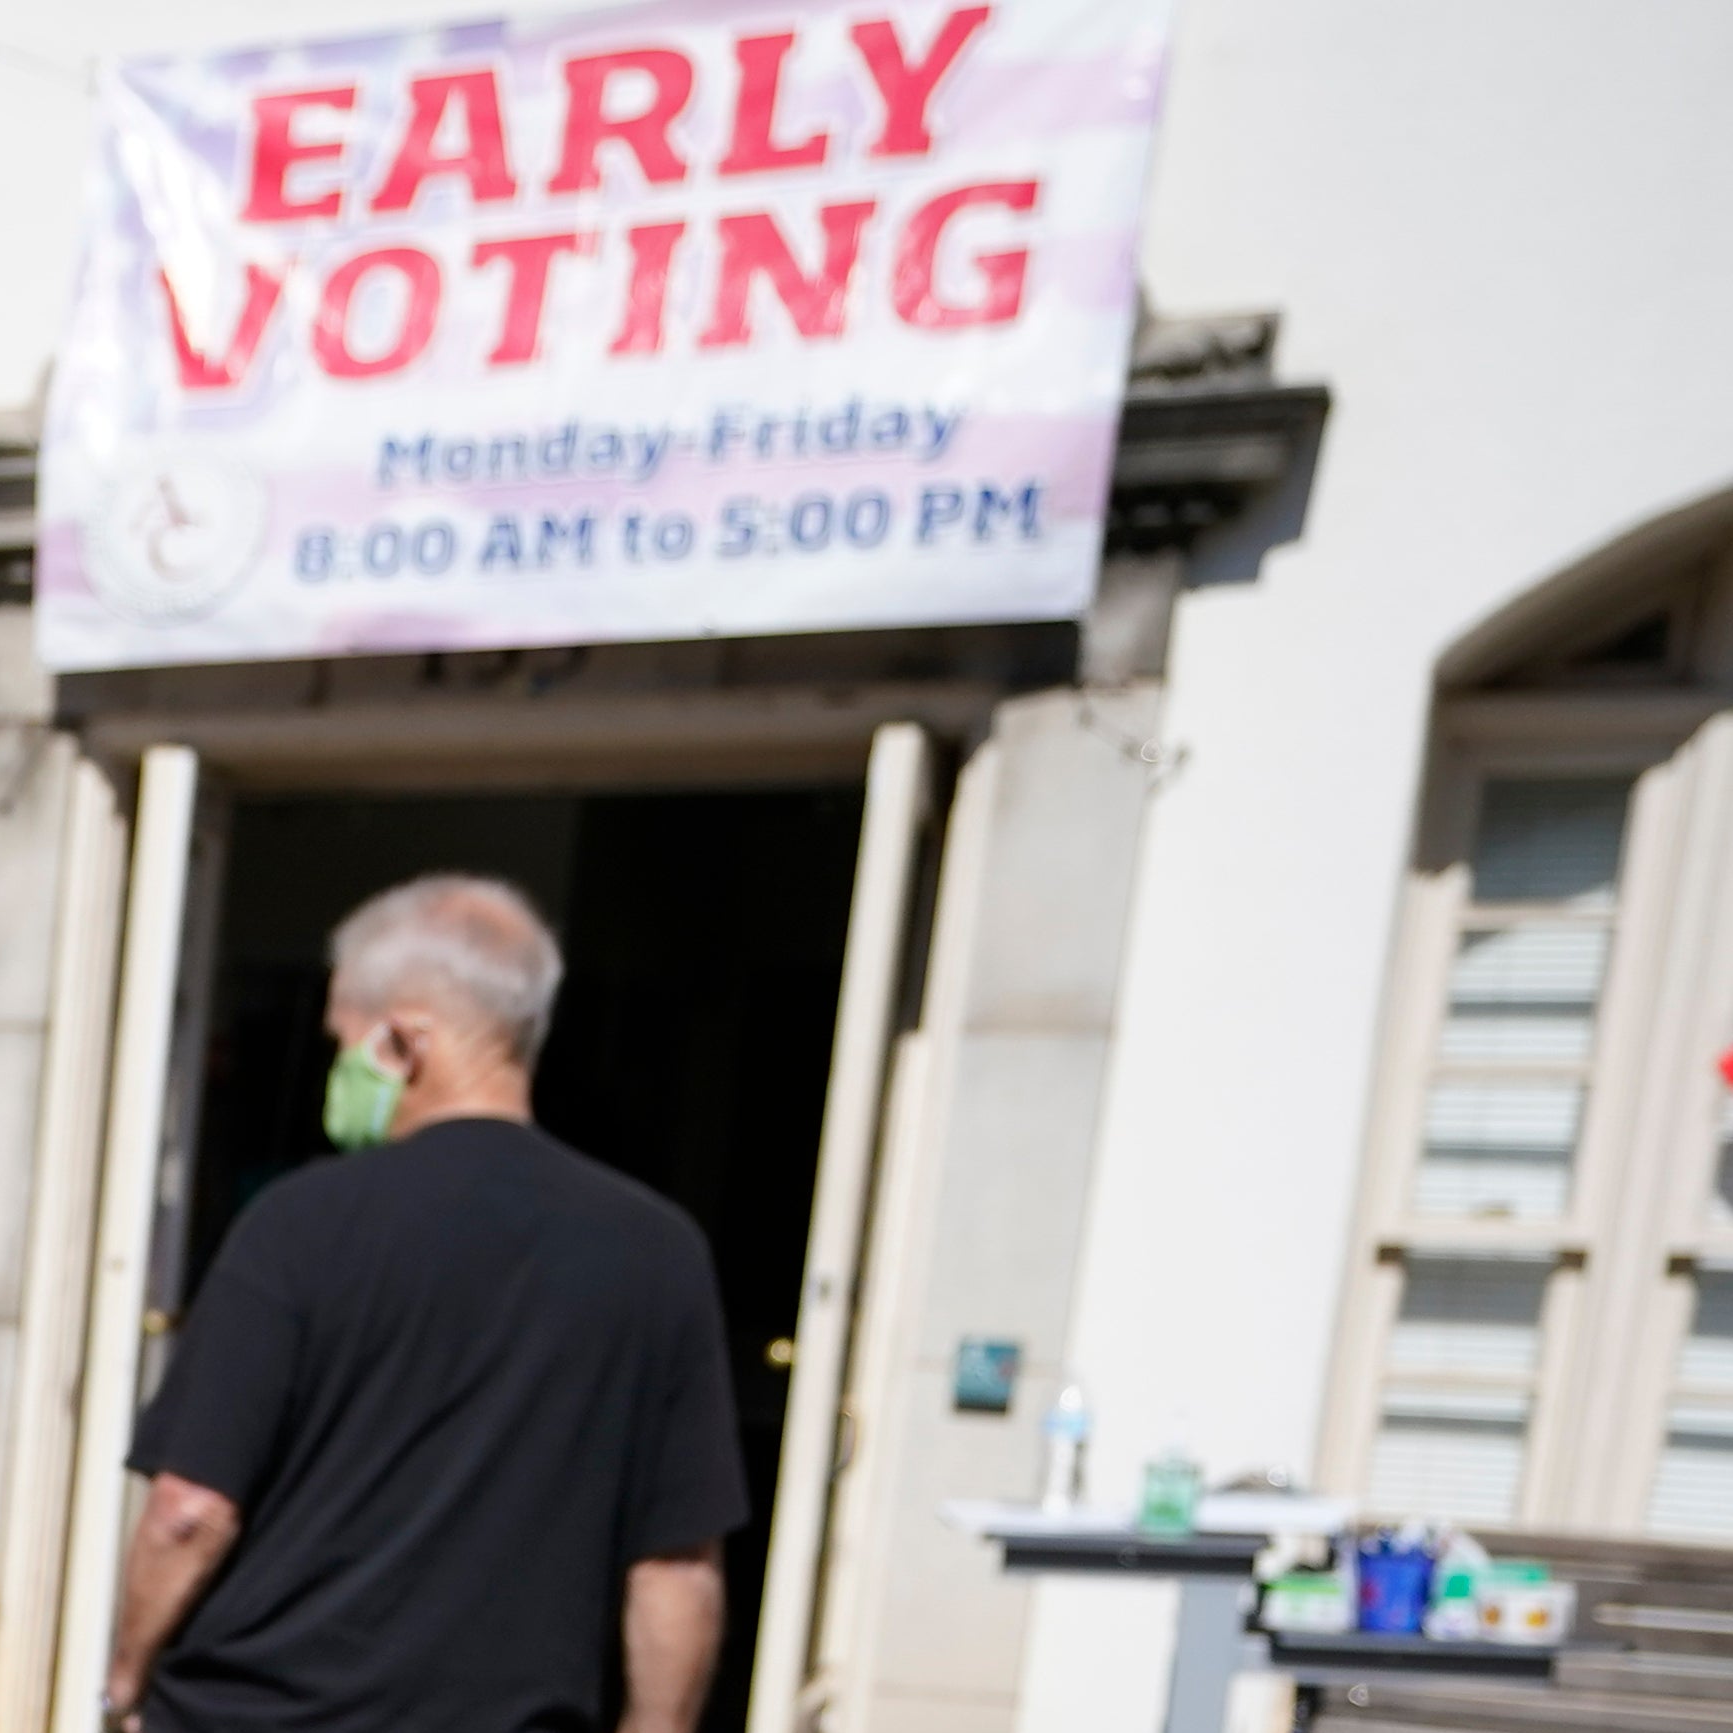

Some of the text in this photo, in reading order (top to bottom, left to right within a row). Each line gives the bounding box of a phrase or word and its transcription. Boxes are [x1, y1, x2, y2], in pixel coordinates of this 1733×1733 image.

[240, 5, 988, 222] EARLY
[158, 180, 1039, 390] VOTING
[377, 397, 966, 488] Monday-Friday
[295, 476, 1044, 582] 8:00 AM to 5:00 PM
